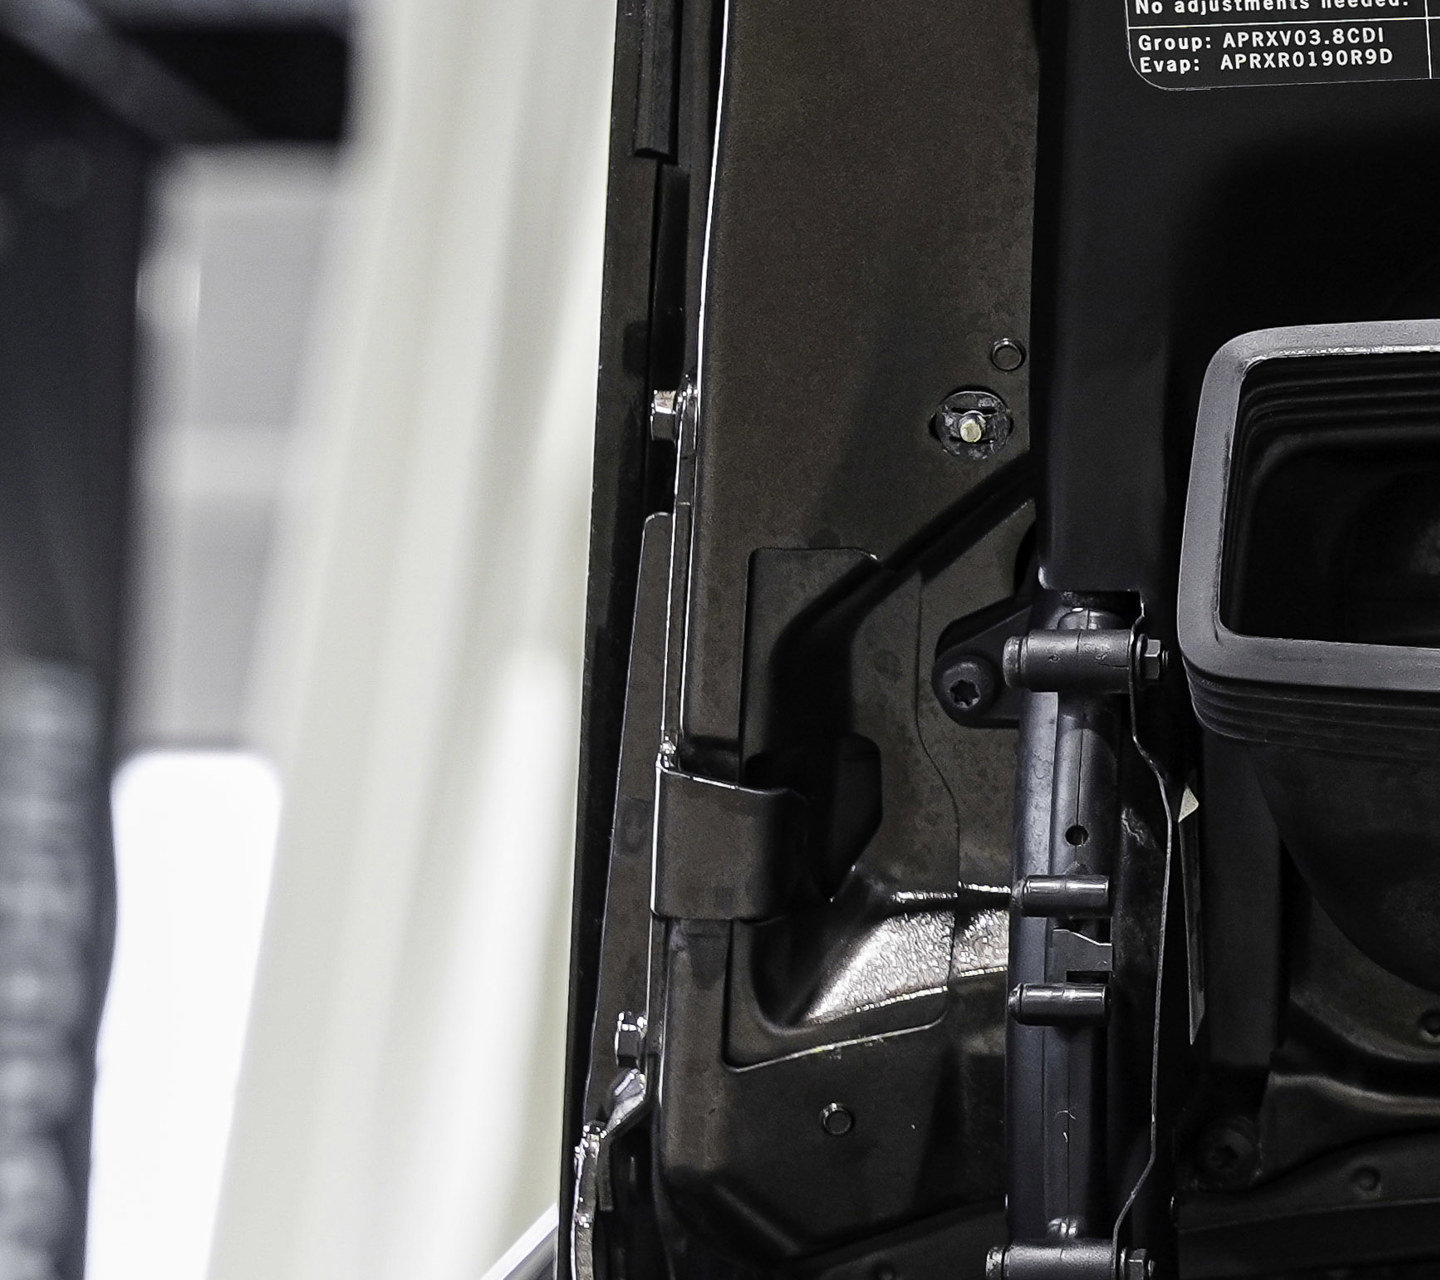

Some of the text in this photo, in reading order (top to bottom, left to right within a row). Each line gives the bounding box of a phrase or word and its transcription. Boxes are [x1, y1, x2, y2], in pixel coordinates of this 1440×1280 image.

[1139, 27, 1385, 52] Group: APRXV03.8CDI
[1140, 56, 1200, 74] Evap:
